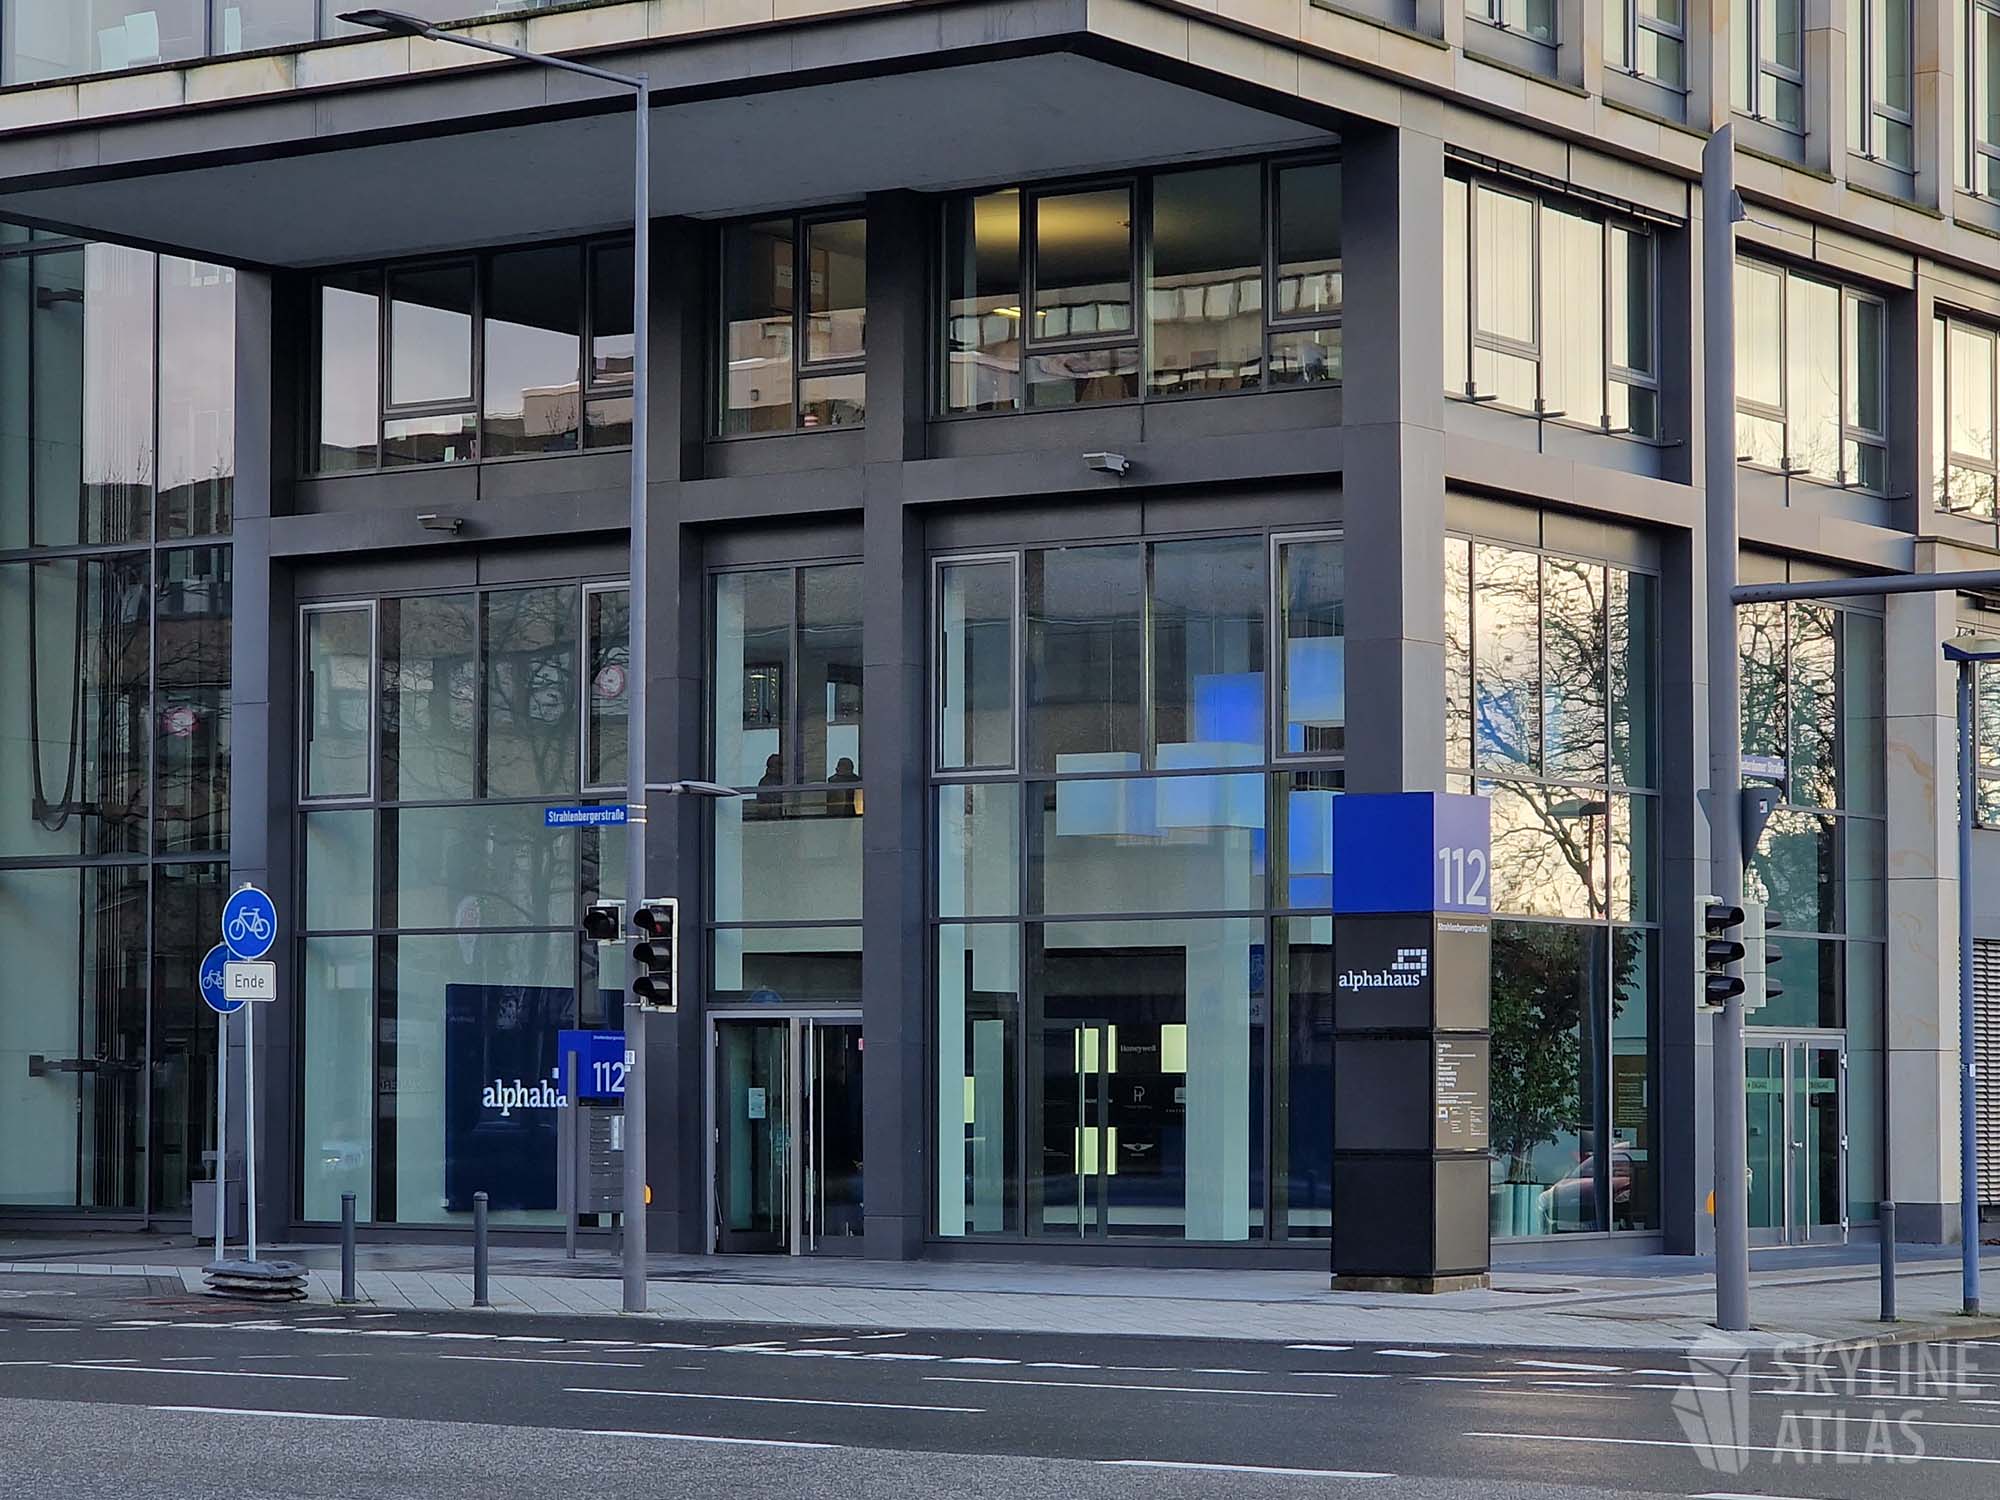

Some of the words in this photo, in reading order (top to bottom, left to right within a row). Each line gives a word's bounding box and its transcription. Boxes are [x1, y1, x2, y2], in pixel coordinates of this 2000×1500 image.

[548, 809, 625, 824] Strahlenbergerstraße
[1438, 847, 1487, 906] 112
[235, 973, 265, 988] Ende
[1339, 970, 1420, 992] alphahaus
[593, 1061, 625, 1093] 112
